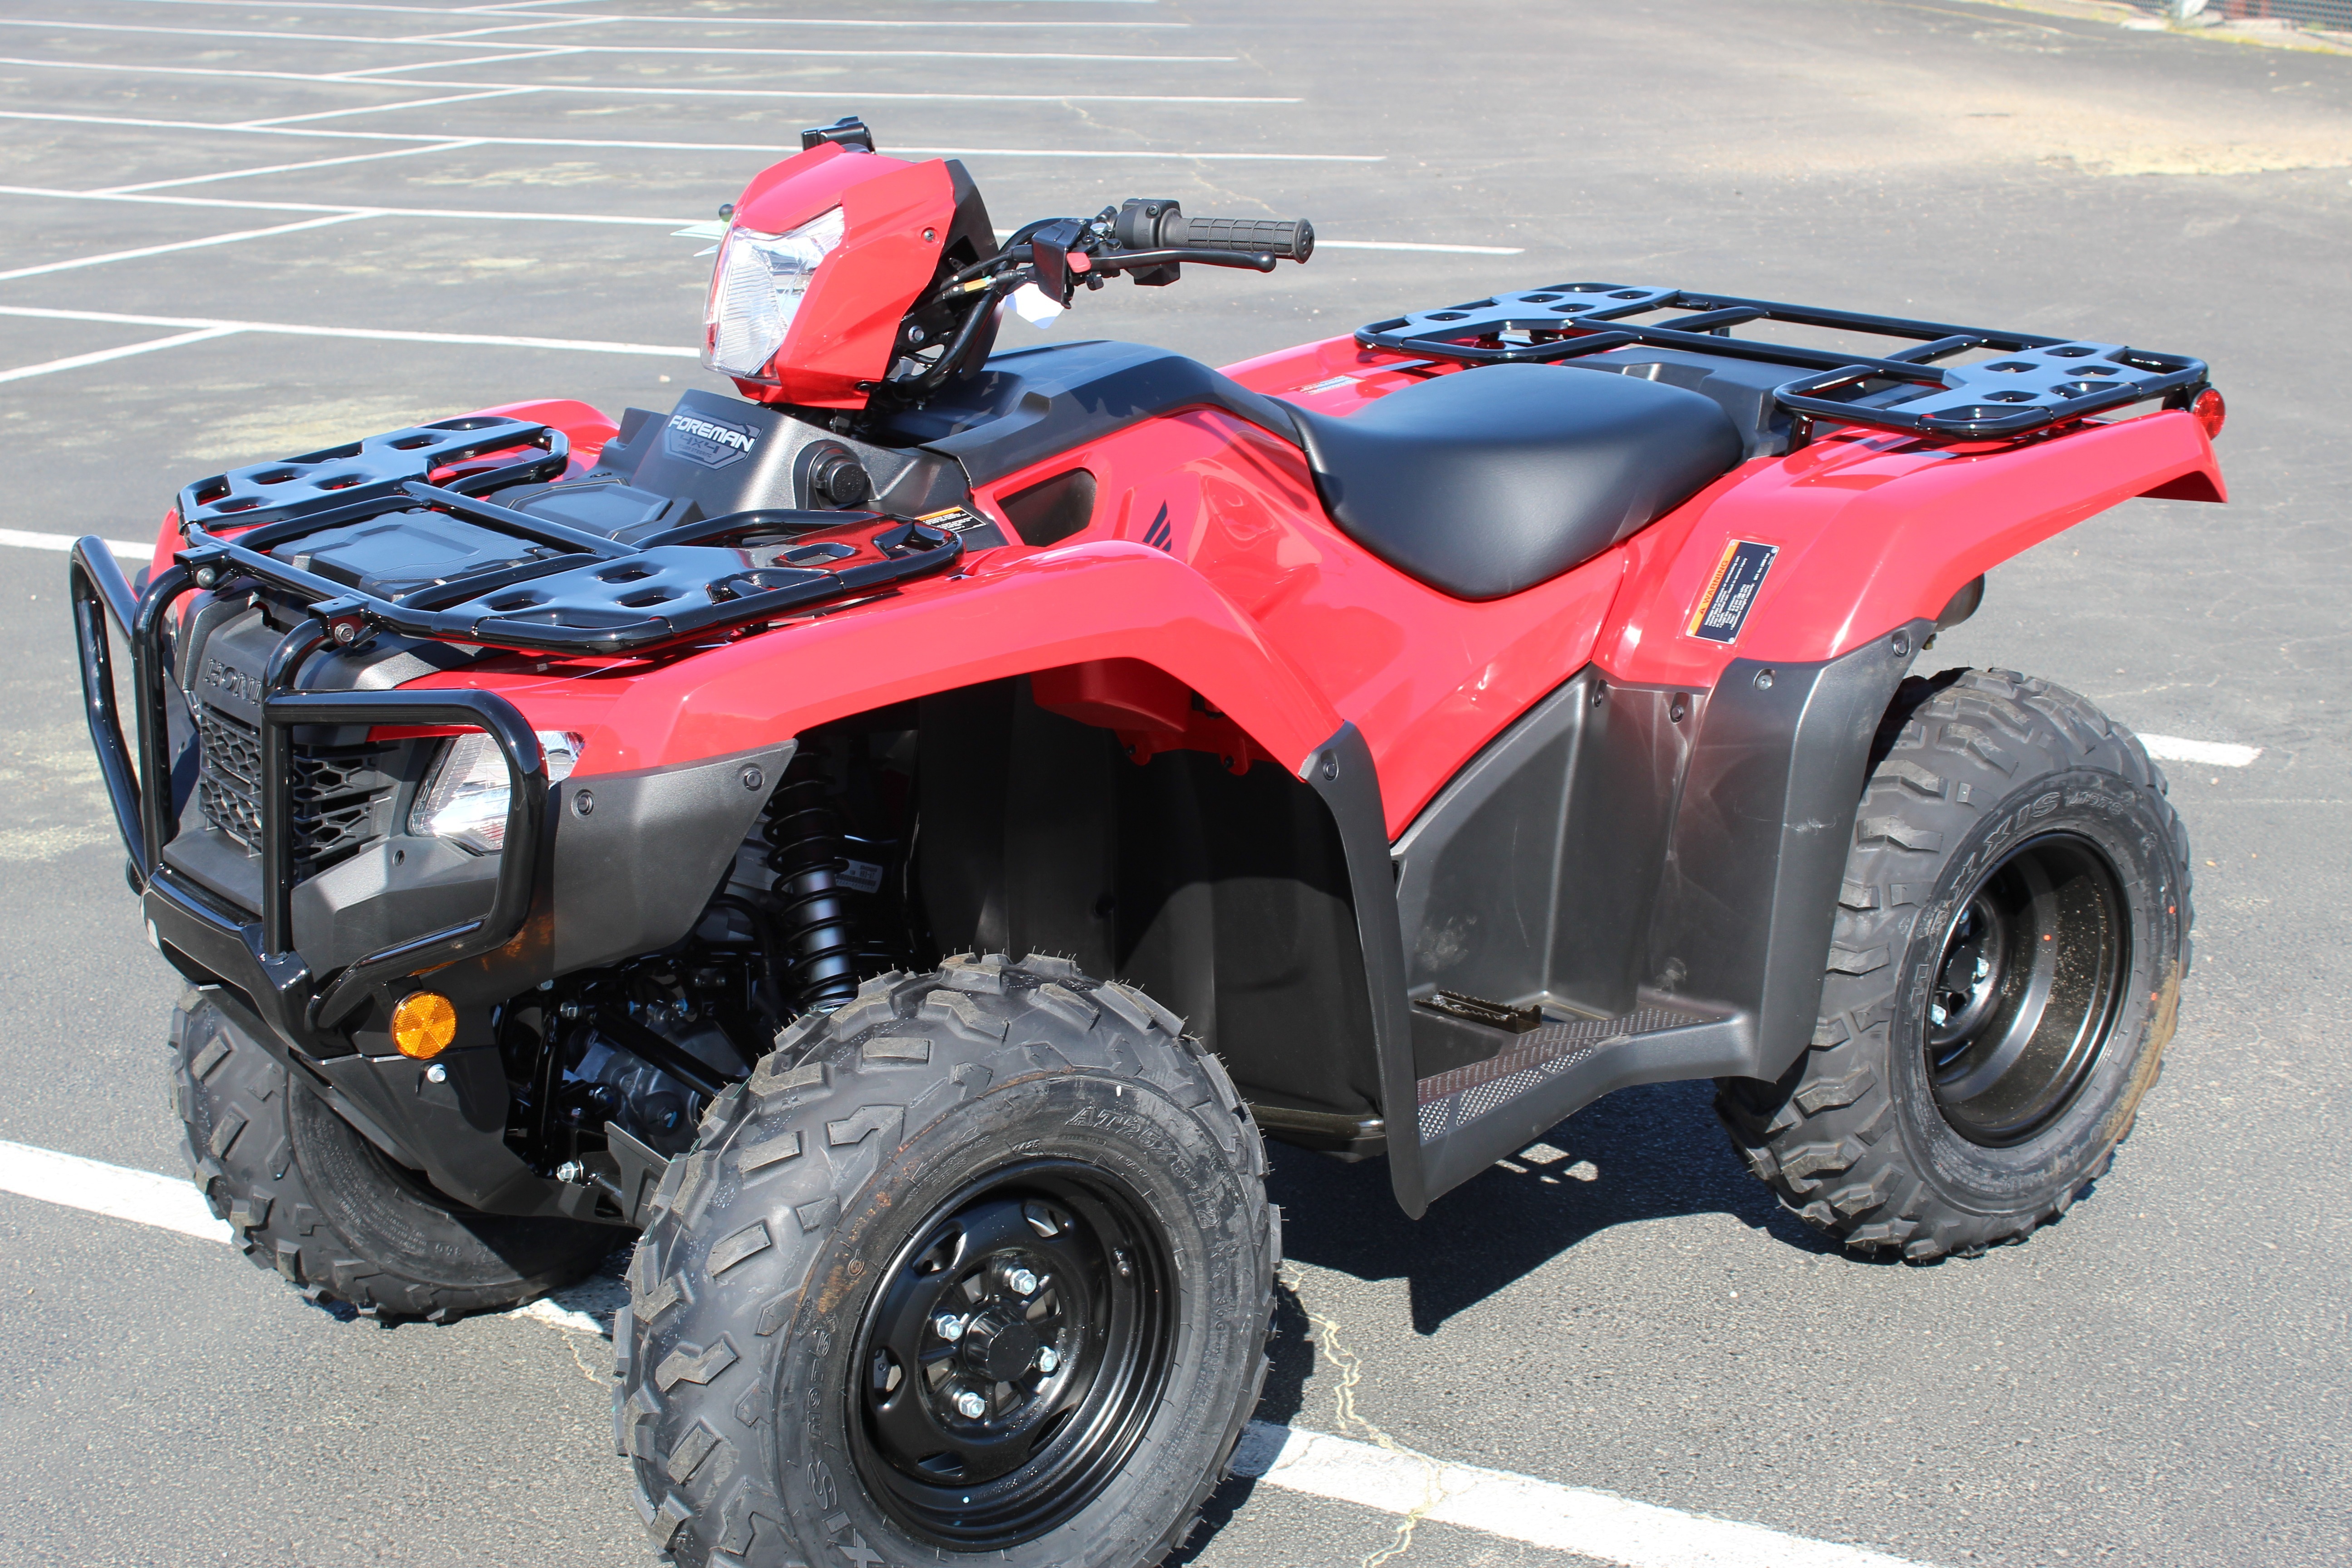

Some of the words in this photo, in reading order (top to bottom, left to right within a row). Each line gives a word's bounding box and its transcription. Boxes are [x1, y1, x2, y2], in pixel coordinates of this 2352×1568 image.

[668, 415, 755, 452] FOREMAN
[1703, 560, 1729, 604] WARNING
[204, 658, 262, 707] HON
[2070, 791, 2124, 816] M978
[807, 1460, 885, 1568] XIS
